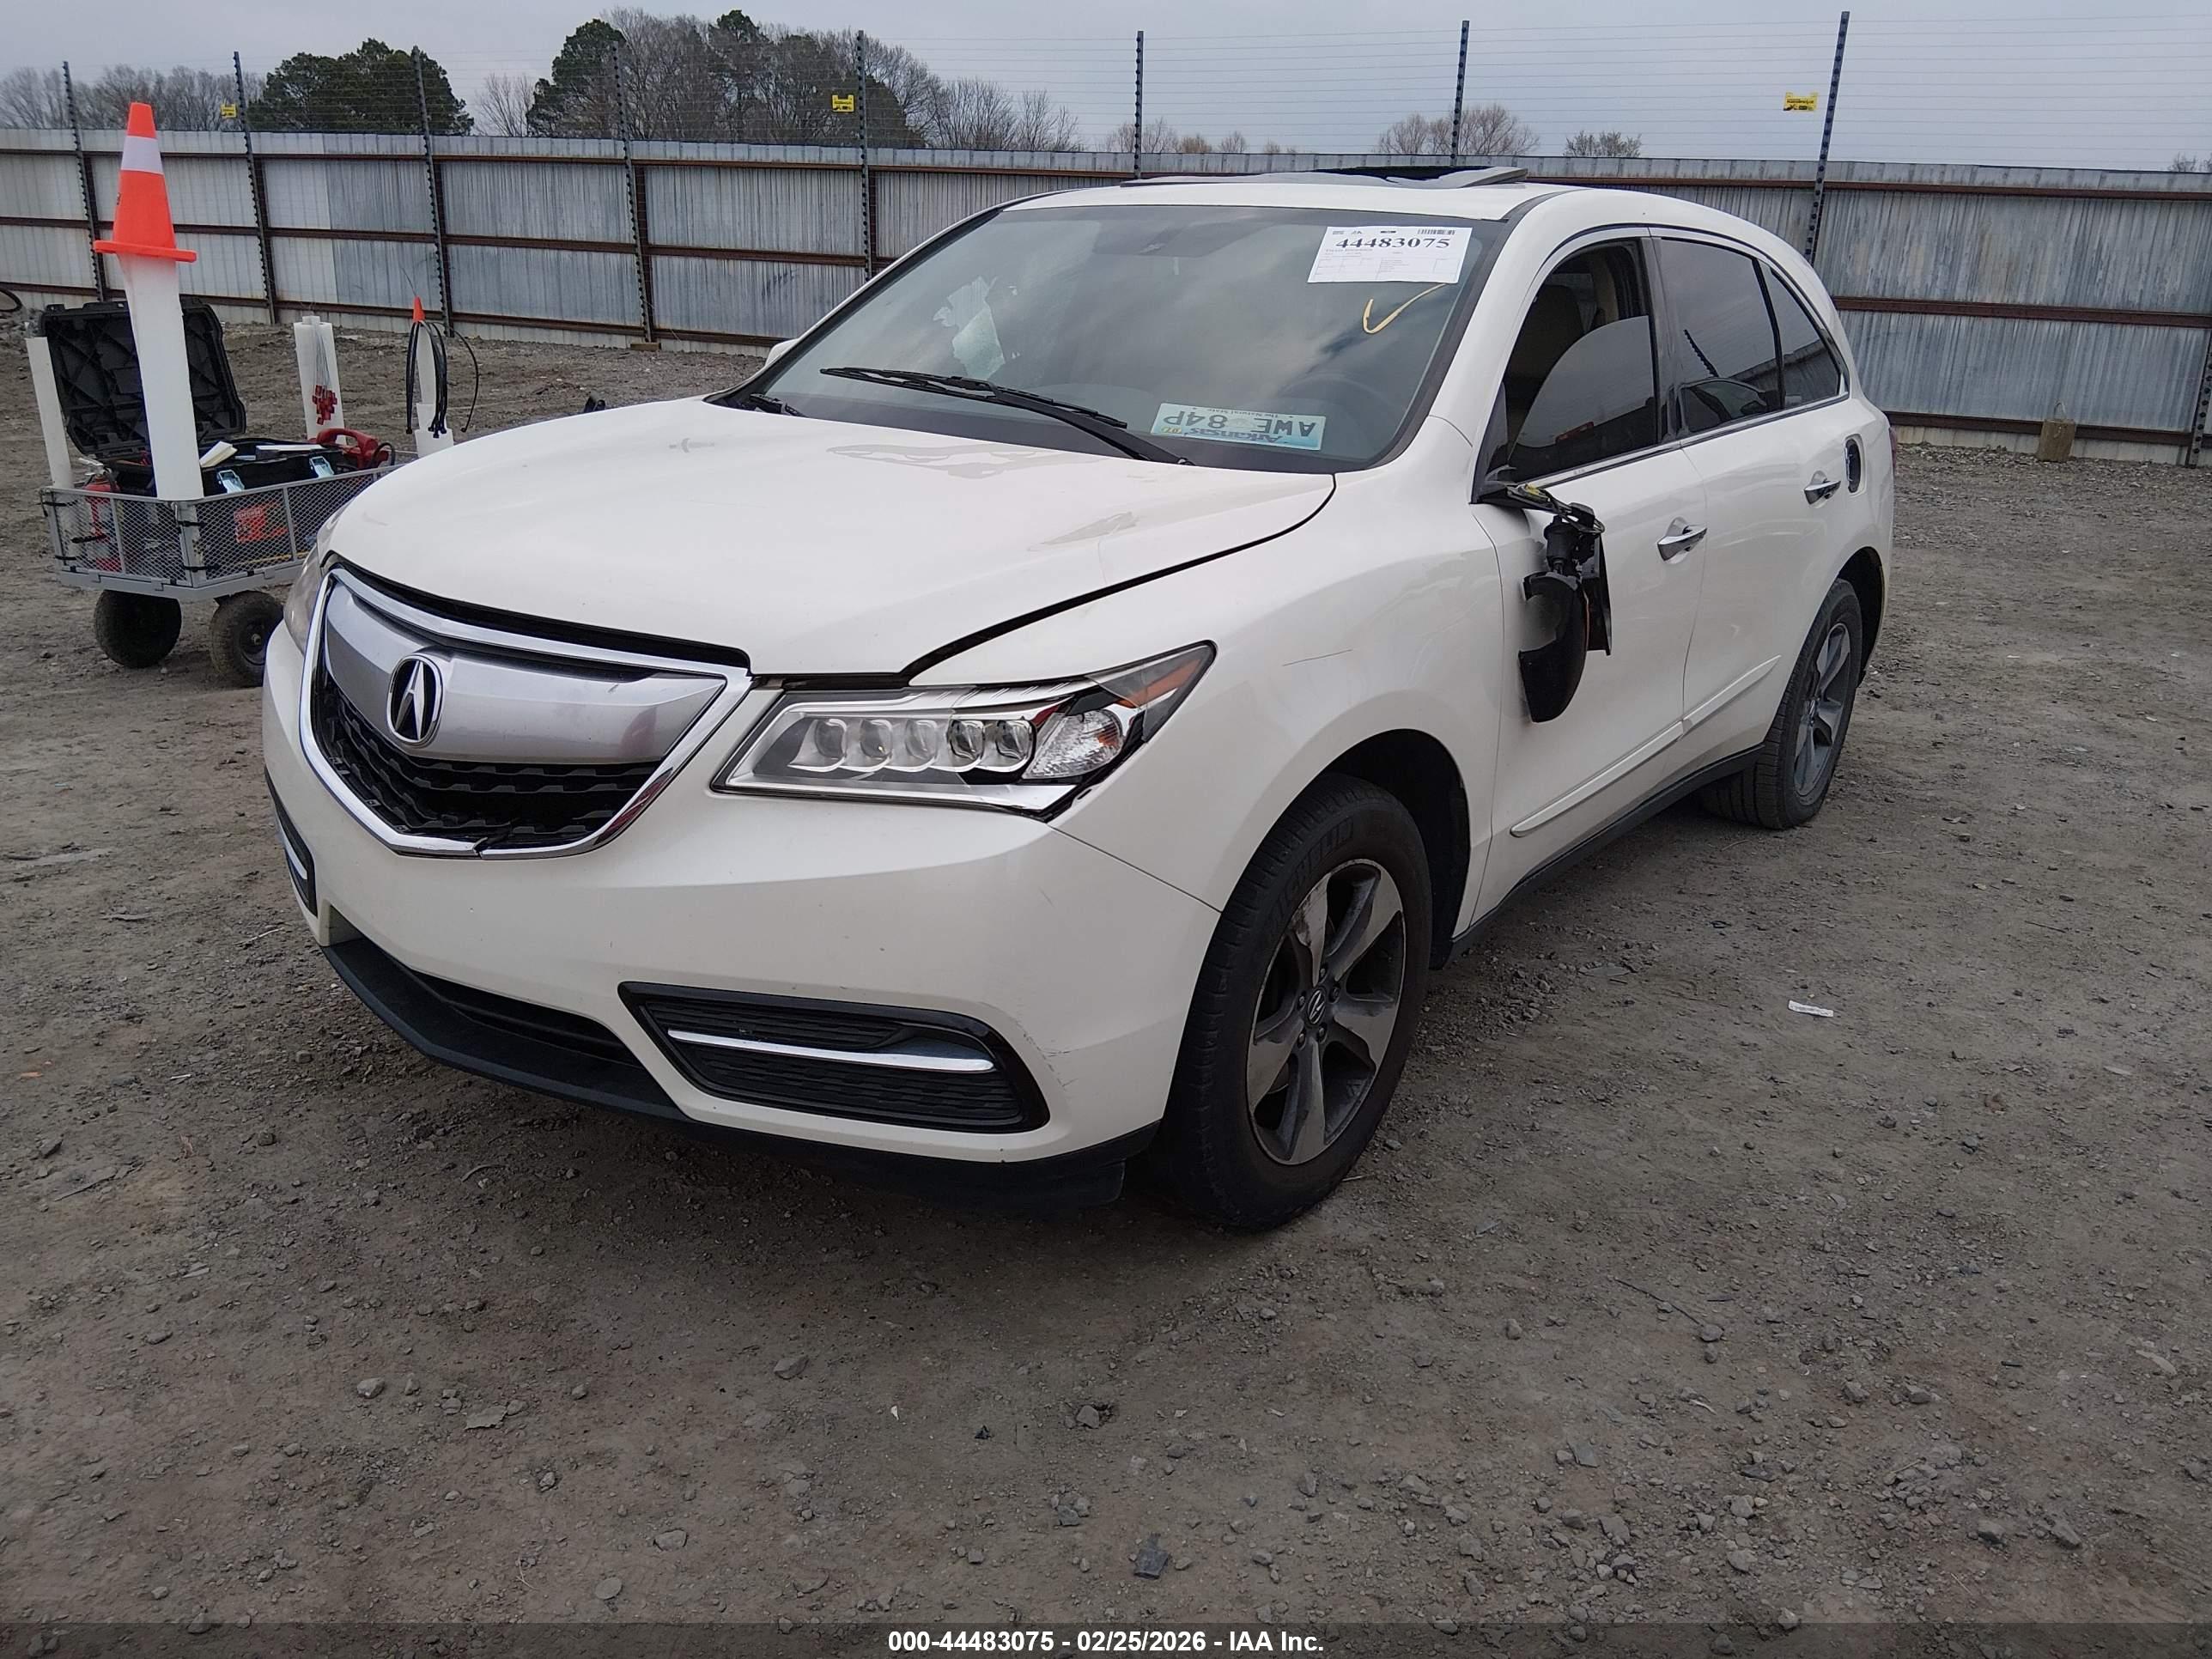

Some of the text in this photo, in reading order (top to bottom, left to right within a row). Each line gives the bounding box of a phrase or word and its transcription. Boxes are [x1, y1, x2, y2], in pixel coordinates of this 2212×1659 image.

[1335, 237, 1450, 249] 44483075
[1163, 410, 1317, 437] AWE 84P
[1189, 428, 1283, 444] Arkansas
